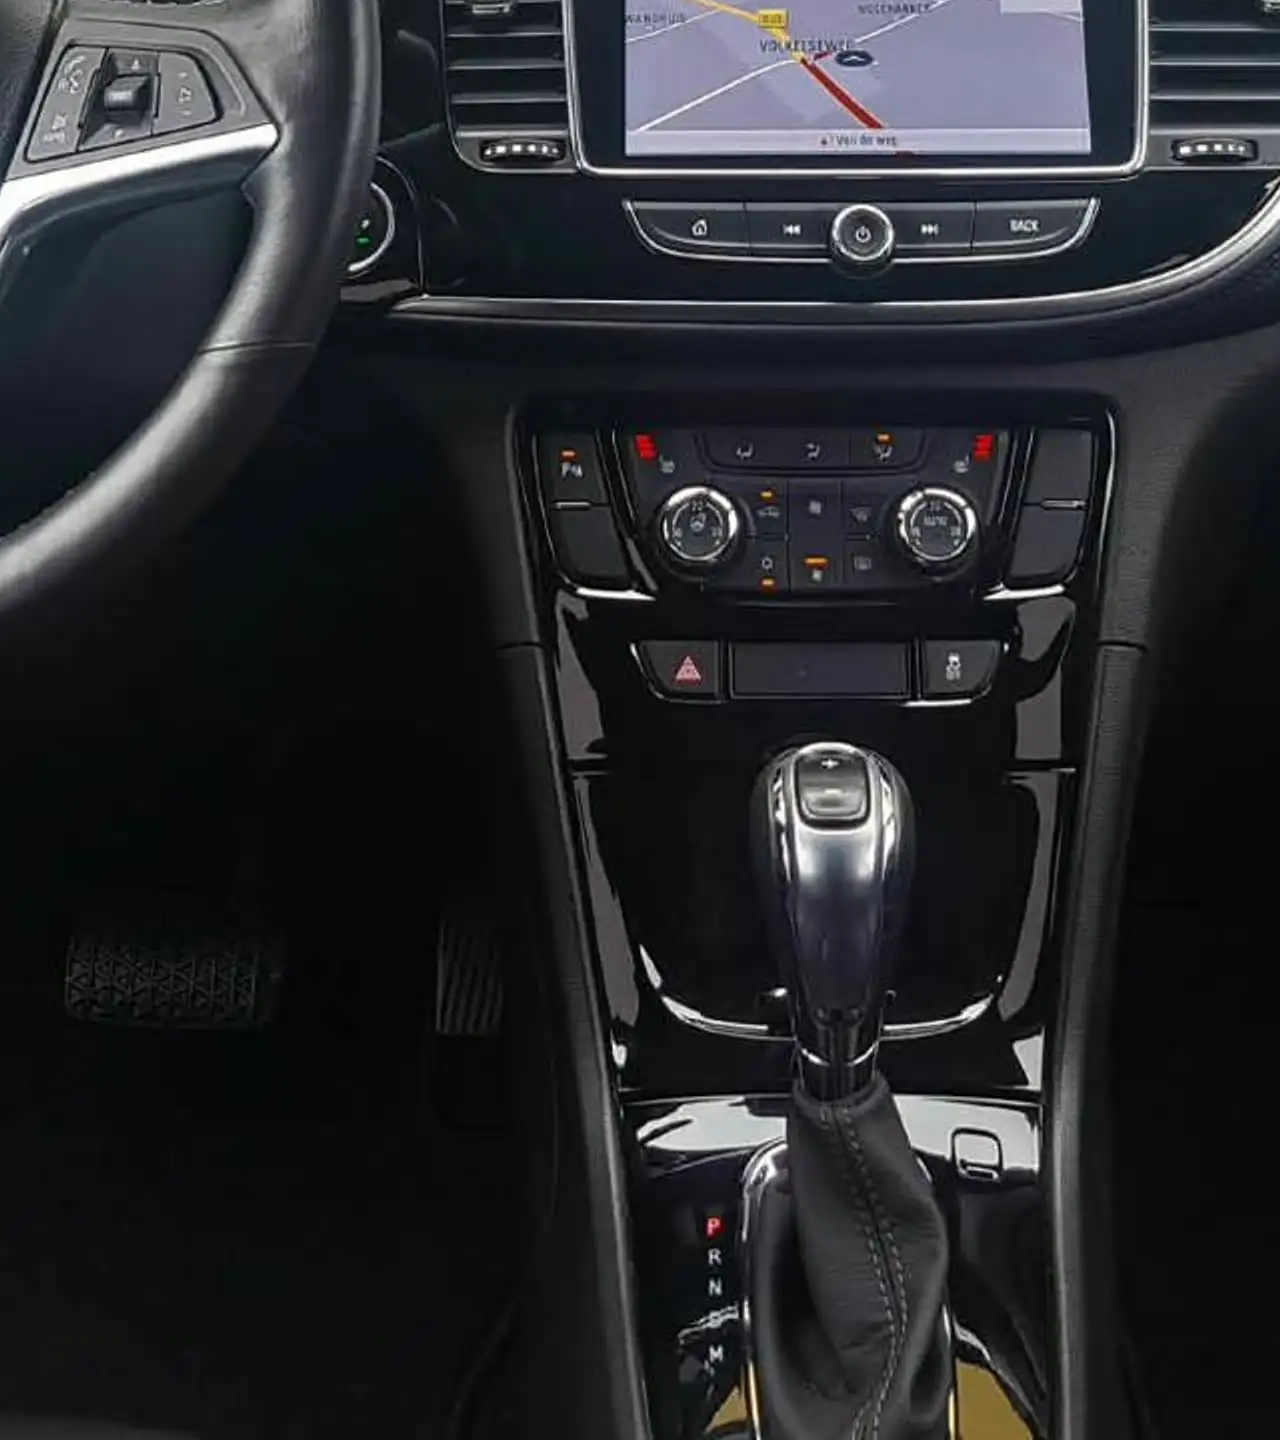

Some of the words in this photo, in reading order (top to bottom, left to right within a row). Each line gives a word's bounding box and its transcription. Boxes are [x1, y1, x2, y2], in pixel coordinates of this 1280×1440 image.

[707, 1217, 721, 1236] P
[708, 1248, 722, 1265] R
[709, 1277, 723, 1296] N
[709, 1345, 724, 1361] M
